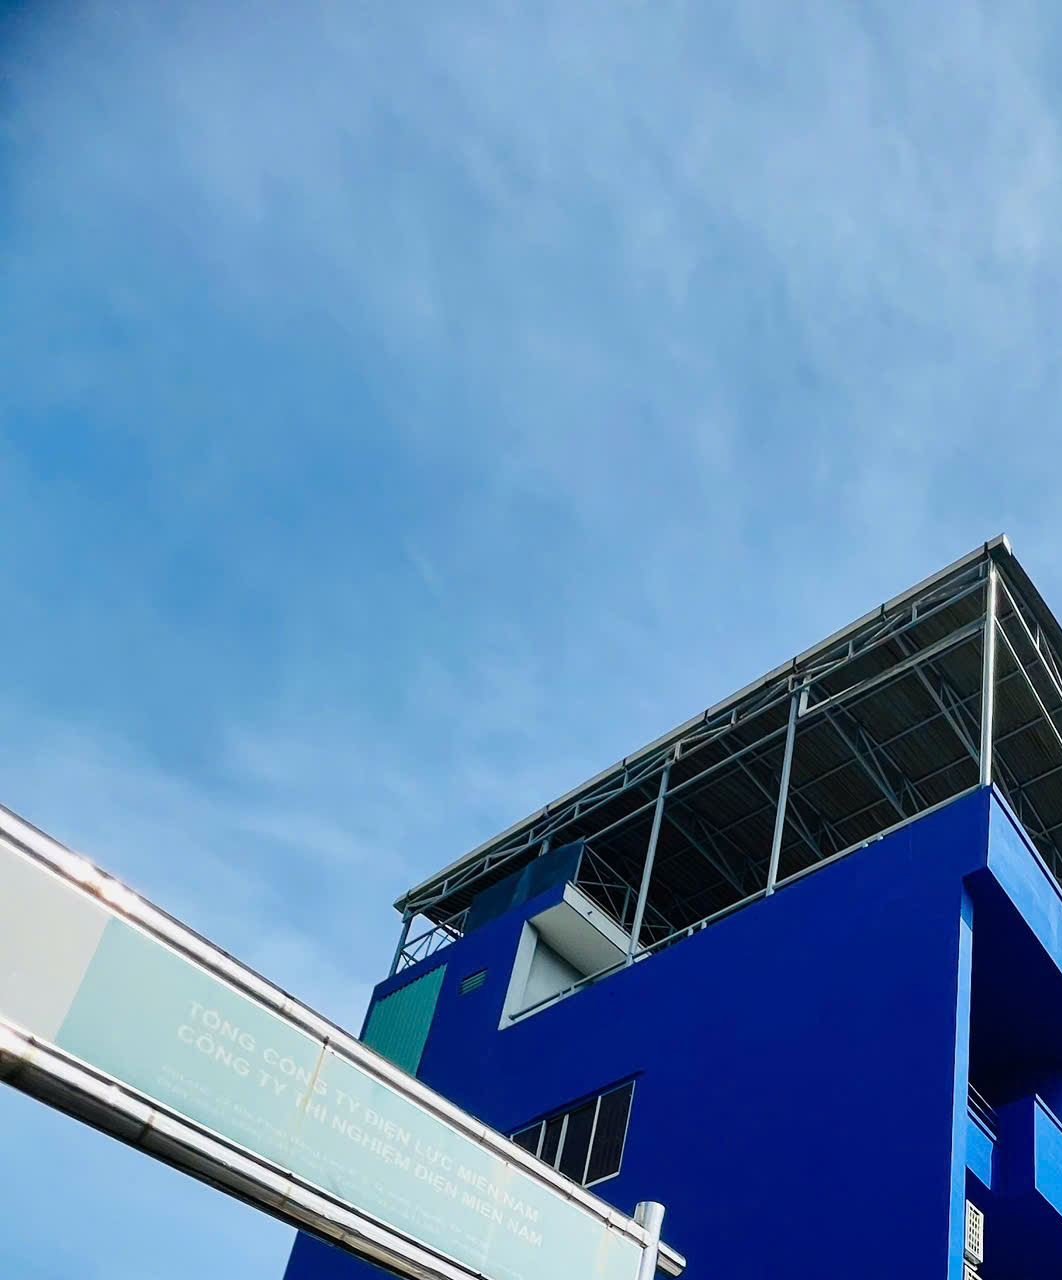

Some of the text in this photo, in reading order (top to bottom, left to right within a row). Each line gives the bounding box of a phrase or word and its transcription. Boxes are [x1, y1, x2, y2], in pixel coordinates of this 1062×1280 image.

[258, 1071, 287, 1096] TY
[507, 1220, 544, 1248] NAM
[503, 1190, 539, 1222] NAM
